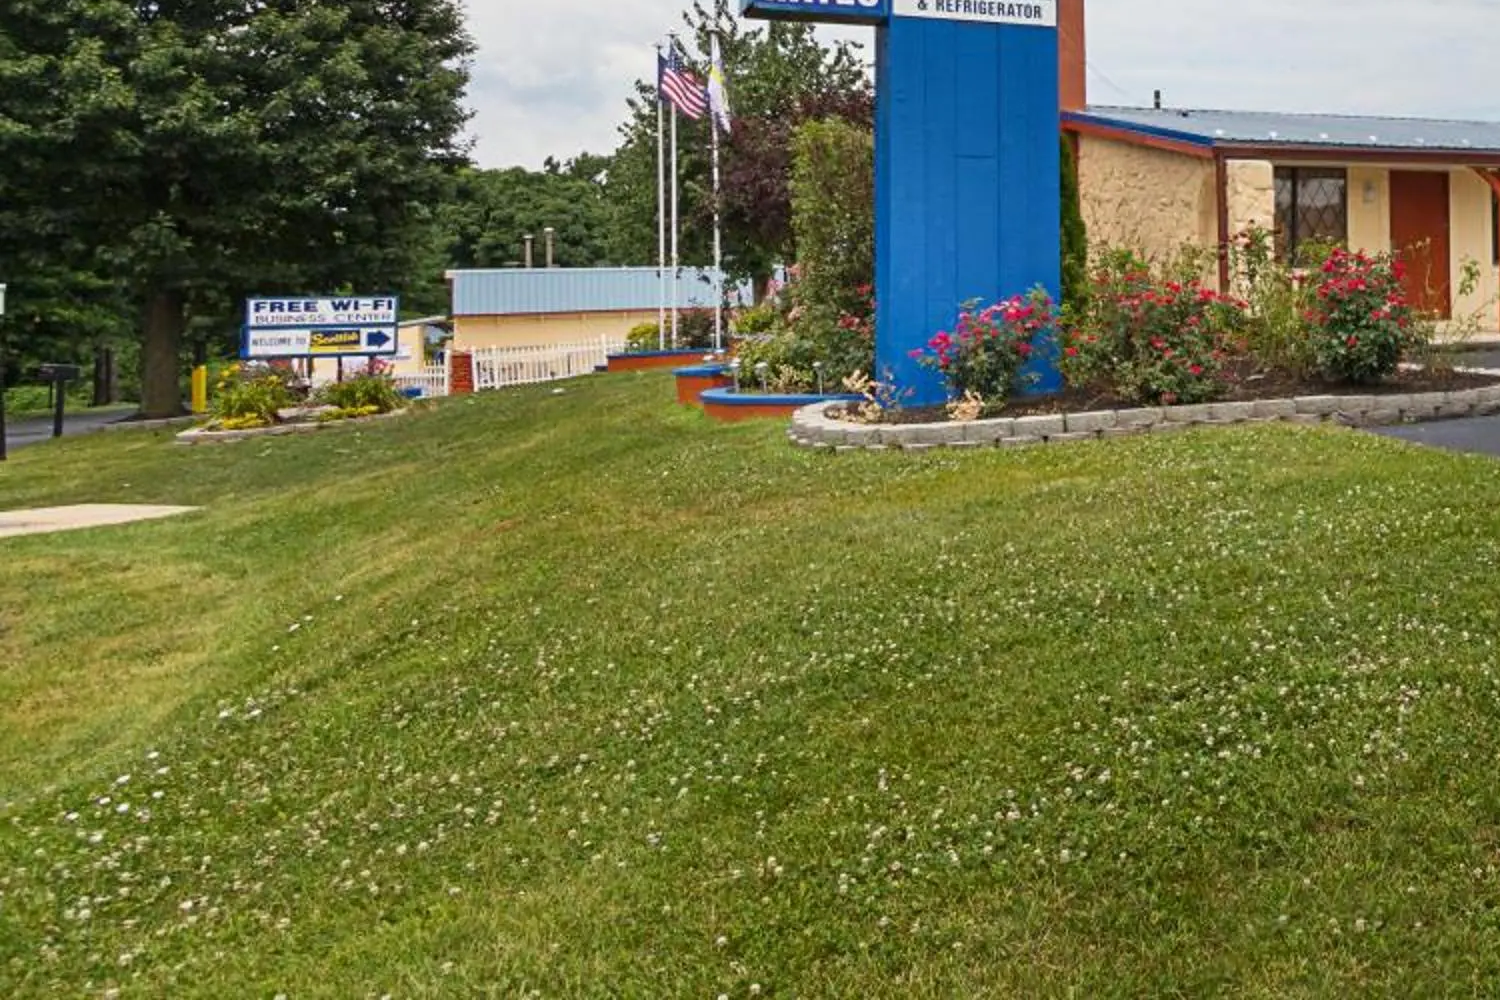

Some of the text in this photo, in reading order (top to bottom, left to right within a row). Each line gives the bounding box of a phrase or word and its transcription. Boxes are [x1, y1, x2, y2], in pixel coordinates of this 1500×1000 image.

[254, 300, 393, 313] FREE WI-FI
[256, 313, 325, 323] BUSINESS
